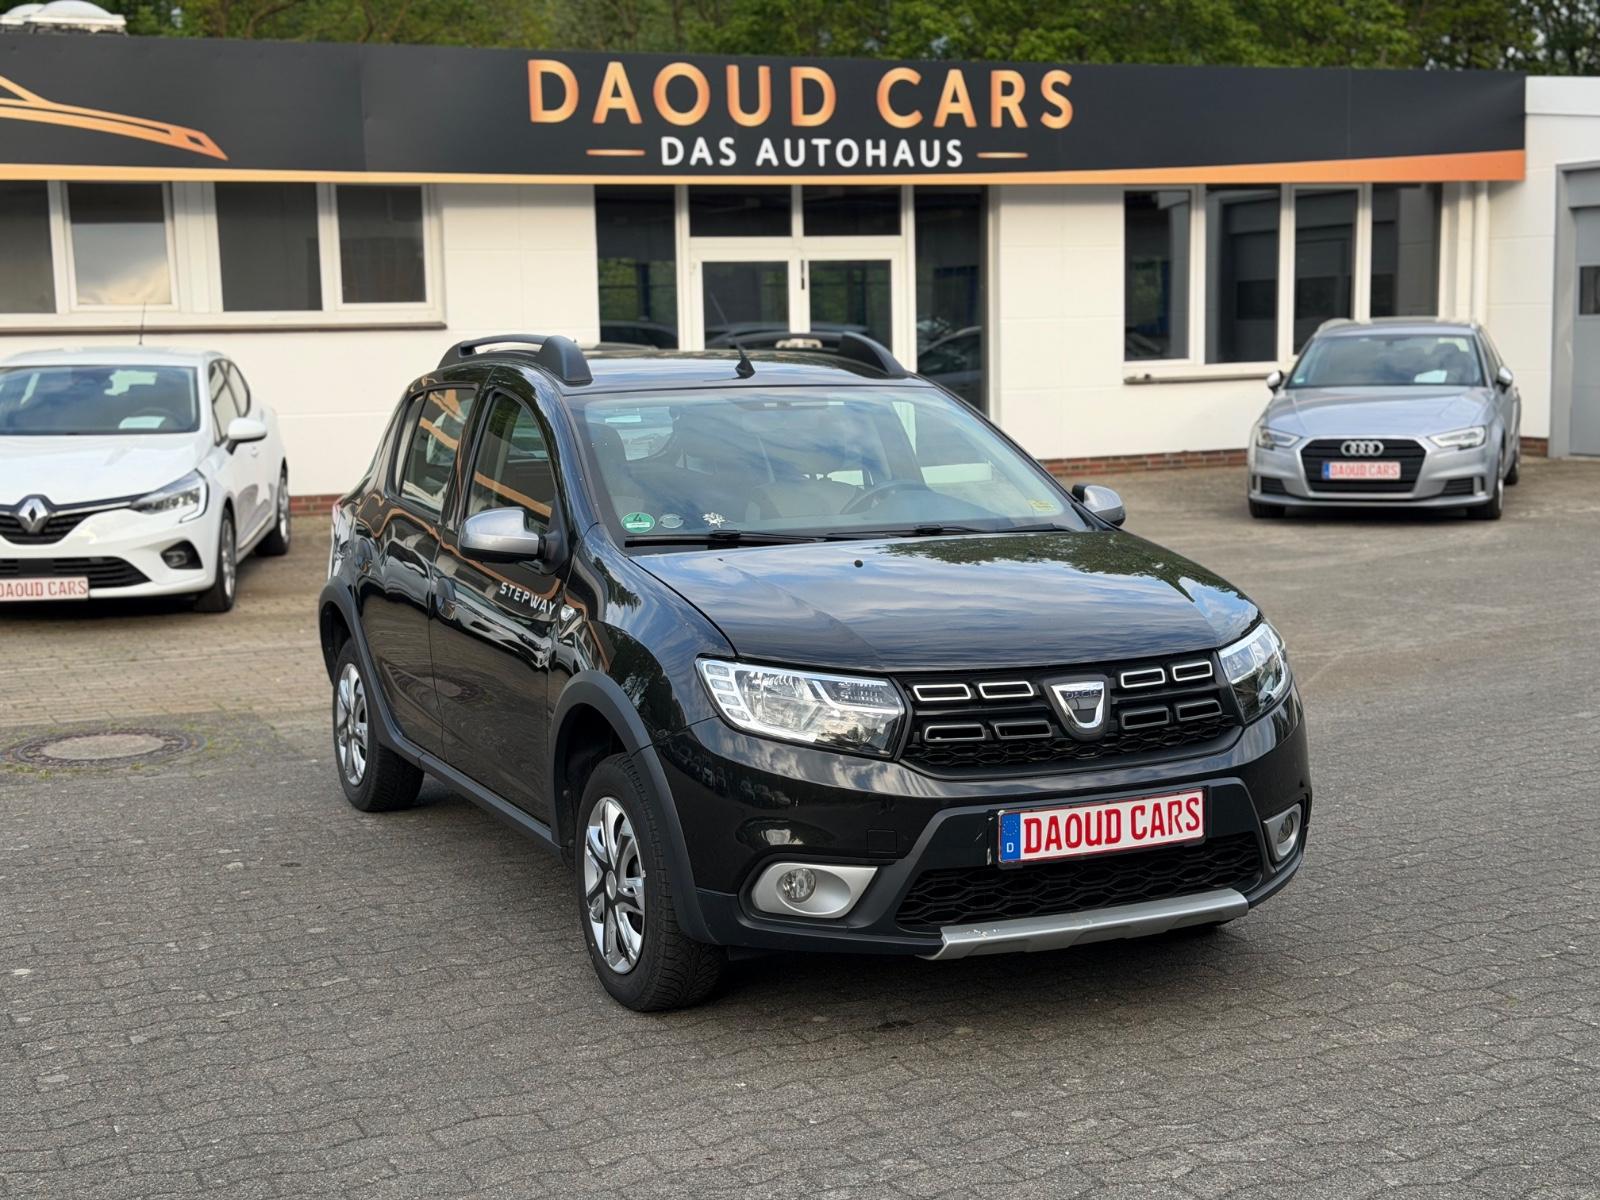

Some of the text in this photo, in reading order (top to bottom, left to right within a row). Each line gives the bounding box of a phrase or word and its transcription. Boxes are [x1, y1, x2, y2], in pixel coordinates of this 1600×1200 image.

[527, 59, 1074, 129] DAOUD CARS
[660, 136, 964, 168] DAS AUTOHAUS
[1331, 464, 1367, 476] DAOUD
[1368, 464, 1398, 476] CARS
[47, 580, 88, 596] CARS
[499, 582, 557, 616] STEPWAY
[1023, 797, 1200, 854] DAOUD CARS
[1006, 842, 1014, 853] D
